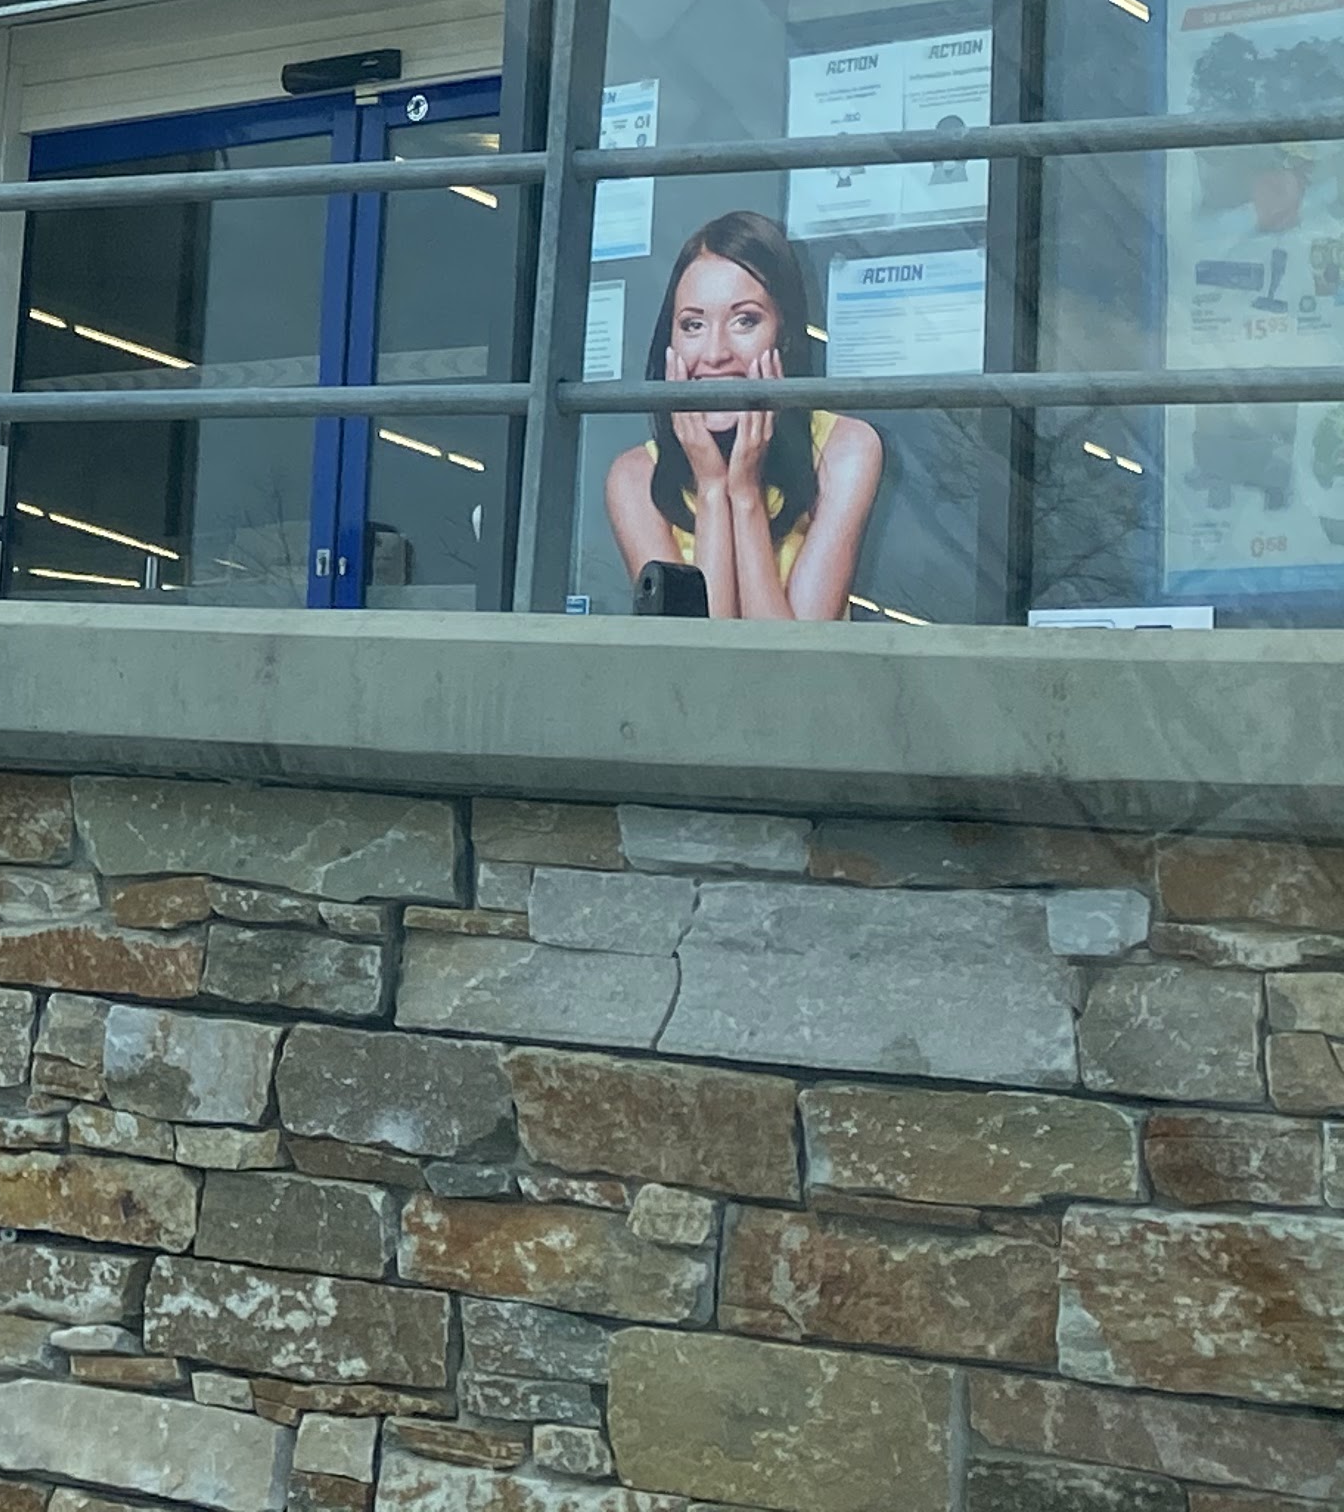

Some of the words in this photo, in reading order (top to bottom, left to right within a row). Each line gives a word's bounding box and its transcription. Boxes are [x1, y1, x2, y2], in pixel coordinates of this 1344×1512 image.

[928, 39, 983, 59] ACTION
[826, 54, 879, 75] ACTION
[863, 264, 924, 285] ACTION
